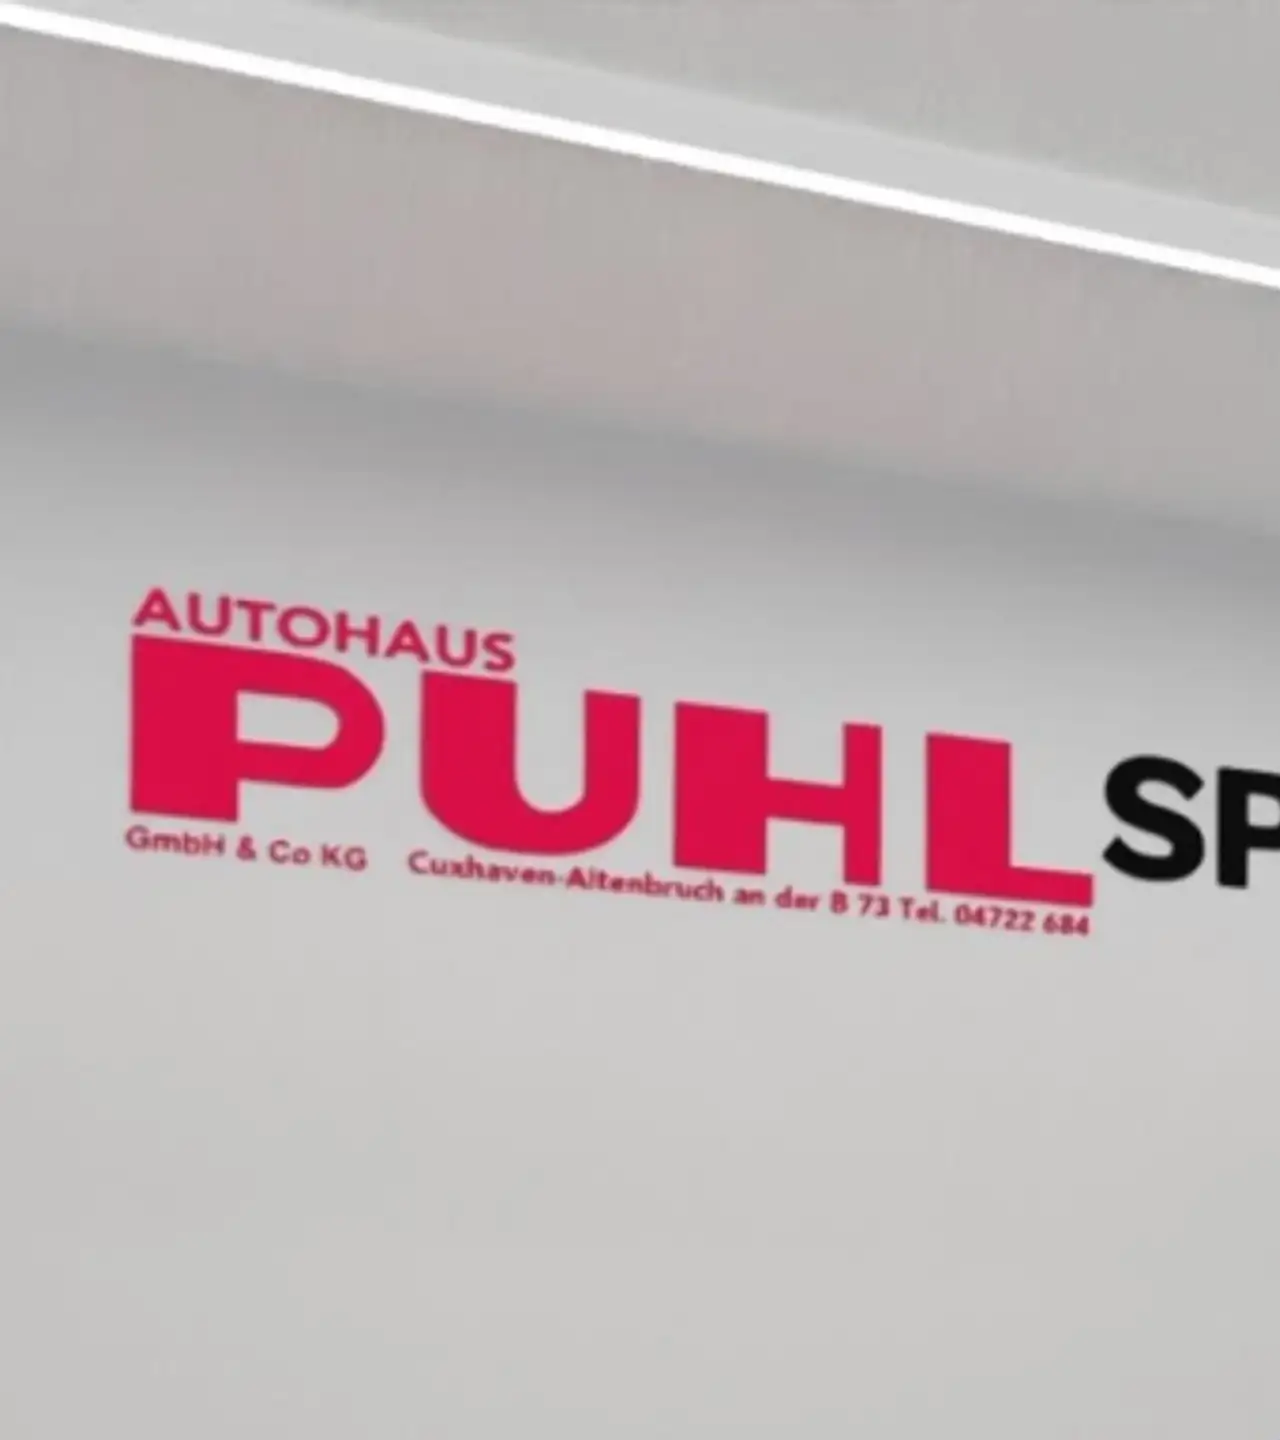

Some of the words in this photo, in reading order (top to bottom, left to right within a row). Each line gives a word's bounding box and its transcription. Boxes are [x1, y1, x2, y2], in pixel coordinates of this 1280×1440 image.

[132, 588, 516, 672] AUTOHAUS
[129, 634, 1093, 908] PUHL
[125, 825, 226, 856] GmbH
[236, 836, 256, 860] &
[268, 840, 311, 865] Co
[321, 844, 368, 871] KG
[407, 850, 724, 902] Cuxhaven-Altenbruch
[734, 887, 766, 906] an
[775, 886, 818, 911] der
[859, 894, 890, 917] 73
[899, 898, 946, 923] Tel.
[955, 904, 1036, 933] 04722
[1043, 913, 1090, 936] 684
